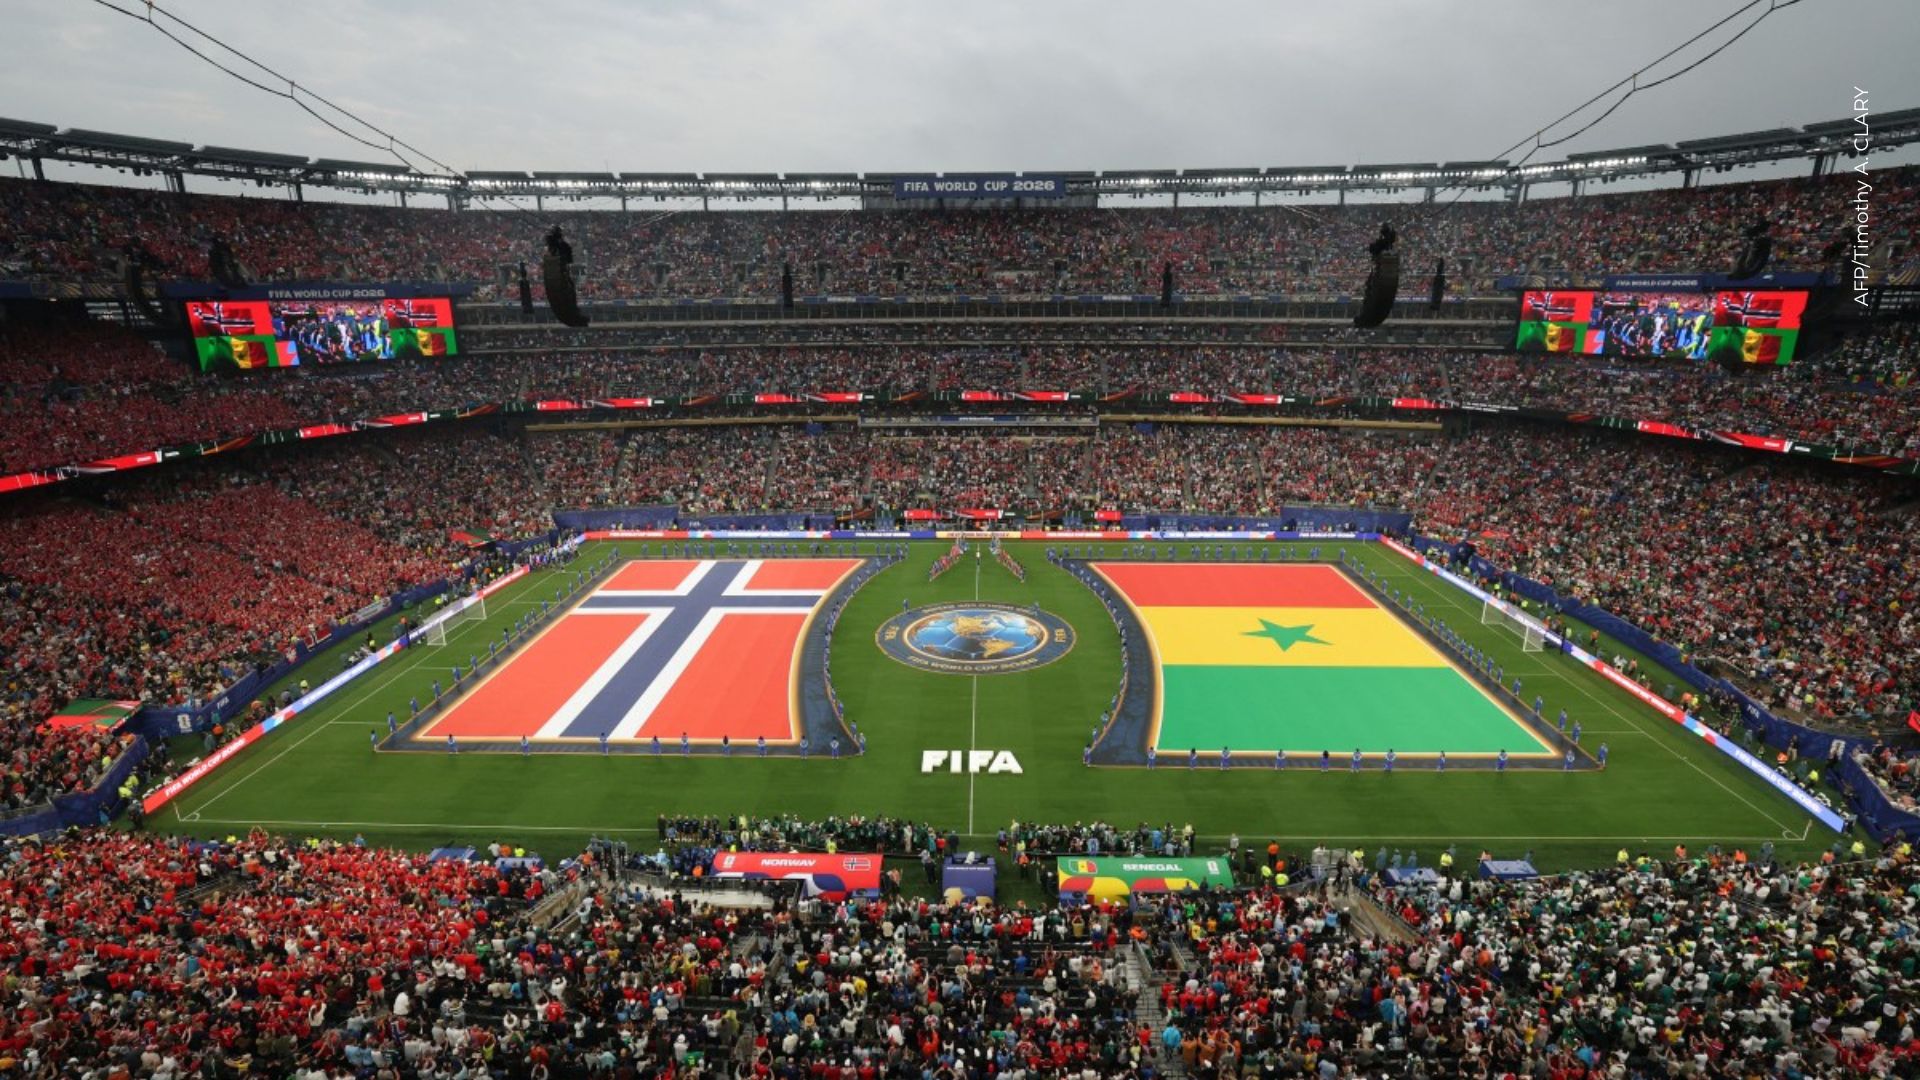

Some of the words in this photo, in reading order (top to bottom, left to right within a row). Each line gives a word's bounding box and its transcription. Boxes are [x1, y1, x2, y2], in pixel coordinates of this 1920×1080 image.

[903, 181, 929, 192] FIFA
[933, 181, 978, 192] WORLD
[983, 180, 1009, 192] CUP
[1012, 180, 1056, 191] 2026
[268, 290, 292, 299] FIFA
[293, 290, 331, 298] WORLD
[332, 290, 352, 298] CUP
[352, 289, 386, 298] 2026
[921, 749, 1024, 774] FIFA
[181, 764, 207, 786] WORLD
[206, 755, 222, 770] CUP
[760, 858, 817, 868] NORWAY
[1122, 863, 1184, 873] SENEGAL
